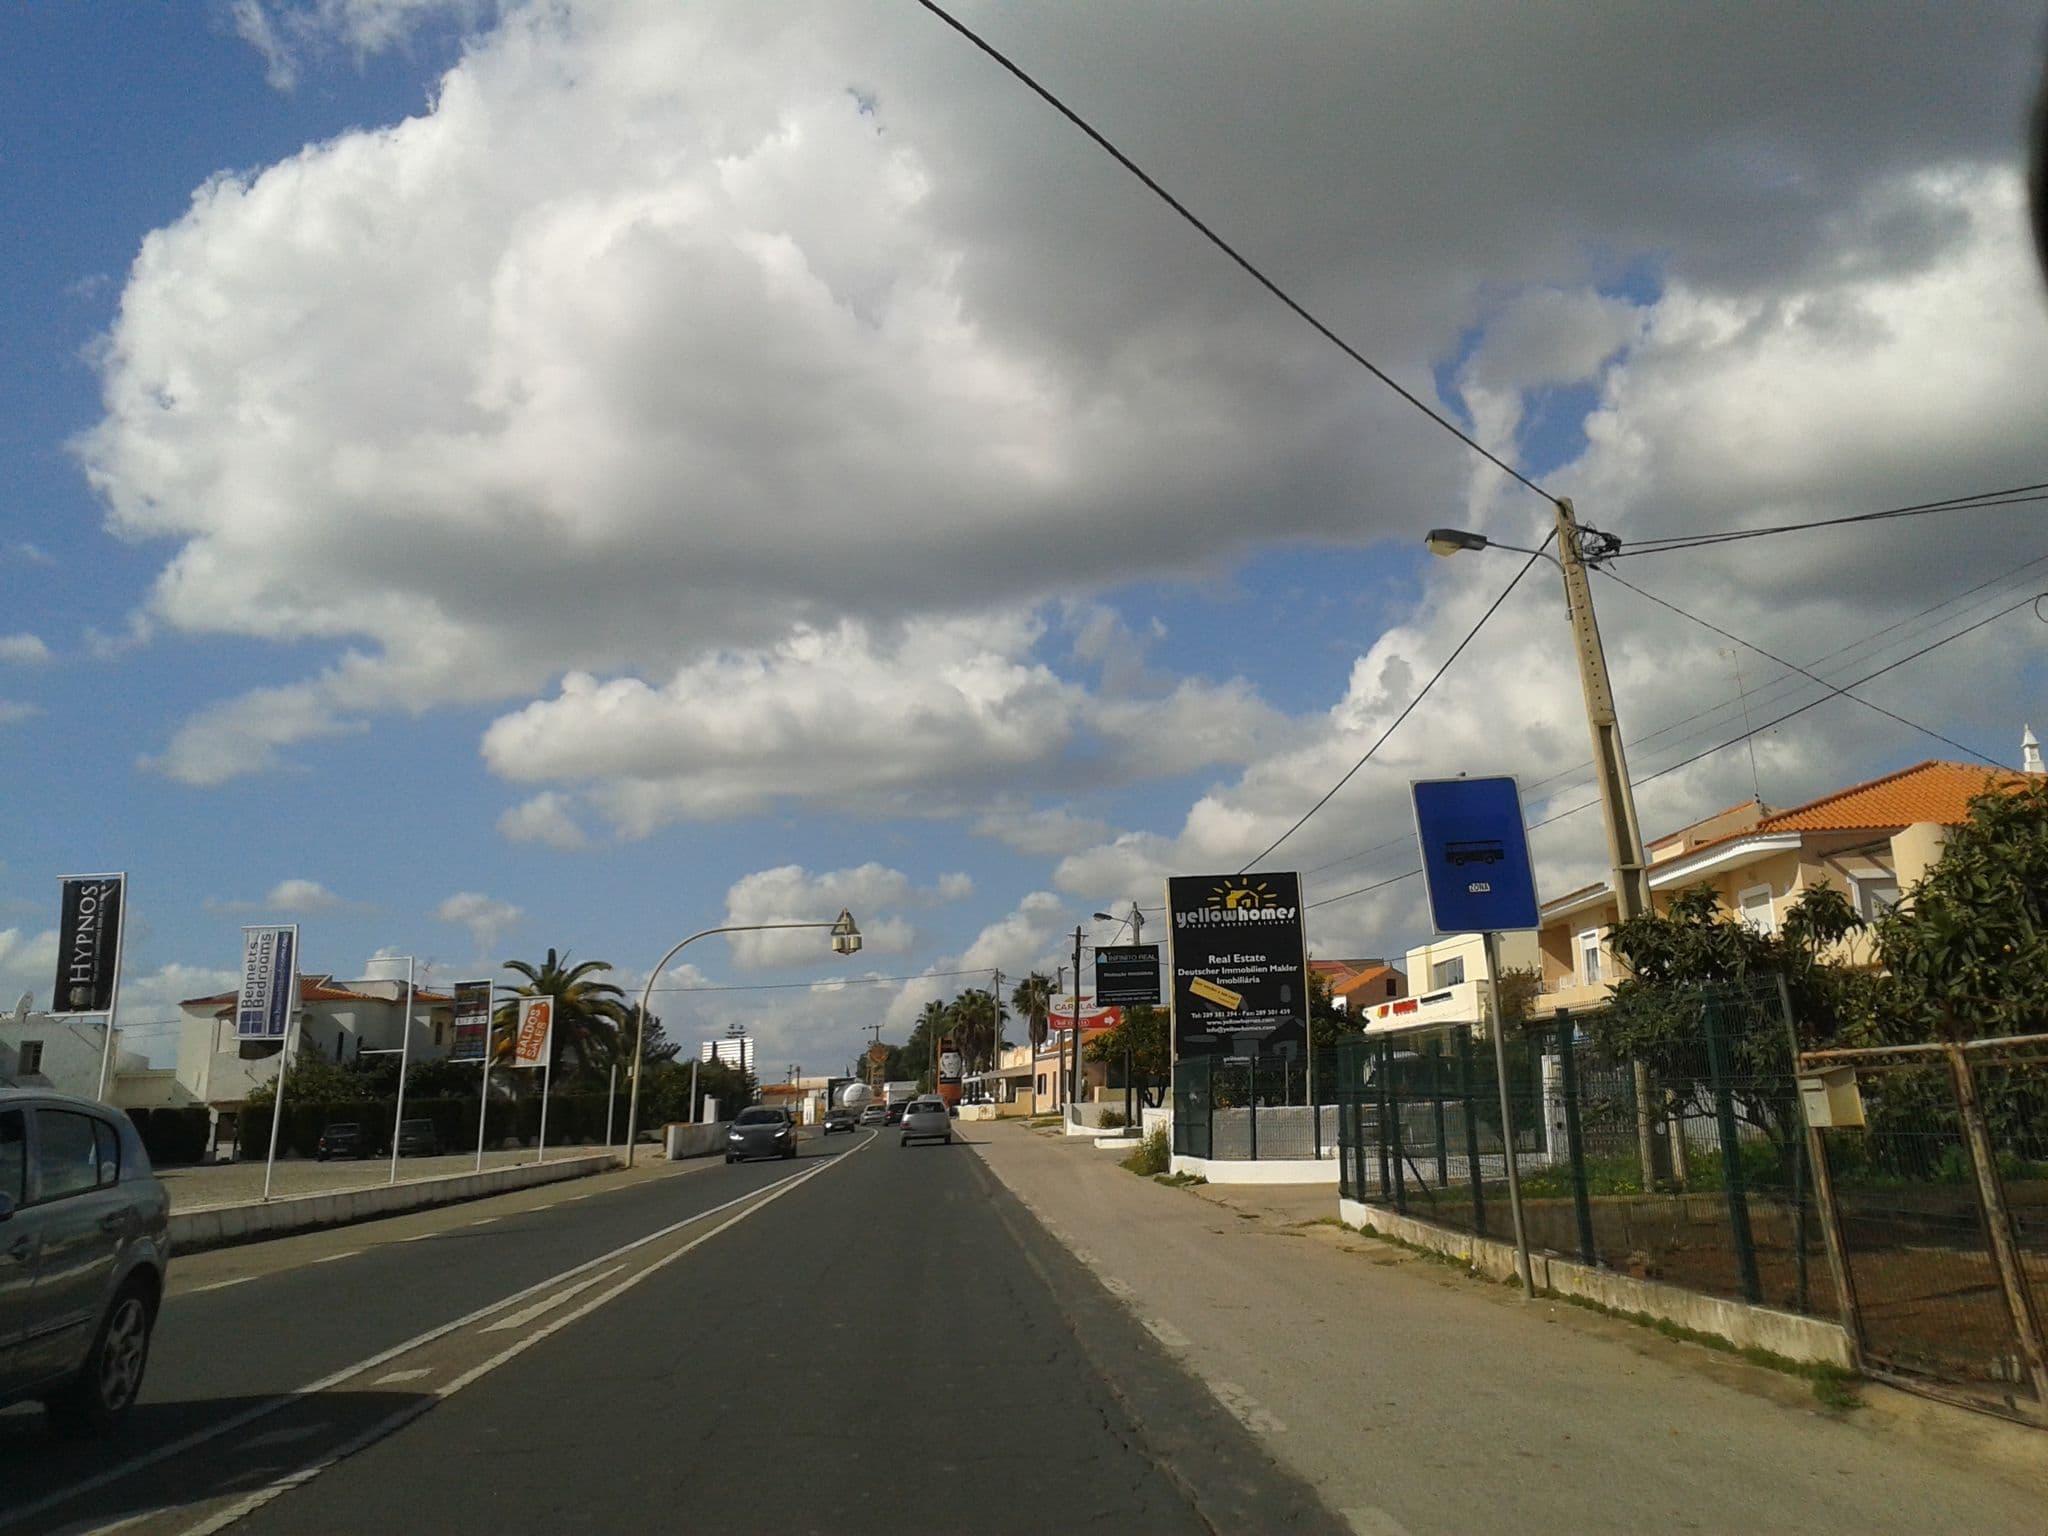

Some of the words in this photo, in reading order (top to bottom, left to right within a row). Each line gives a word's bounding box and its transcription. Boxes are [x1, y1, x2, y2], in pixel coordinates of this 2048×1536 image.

[69, 886, 98, 983] HYPNOS
[1176, 906, 1296, 928] yellowhomes
[241, 942, 258, 1008] Bennetts
[252, 933, 271, 1008] Bedrooms
[1178, 967, 1219, 976] Deutscher
[1221, 965, 1268, 974] Immobilien
[1269, 964, 1298, 973] Makler
[1208, 955, 1230, 964] Real
[1233, 954, 1266, 963] Estate
[517, 1009, 541, 1054] SALDOS
[527, 1022, 546, 1057] SALES
